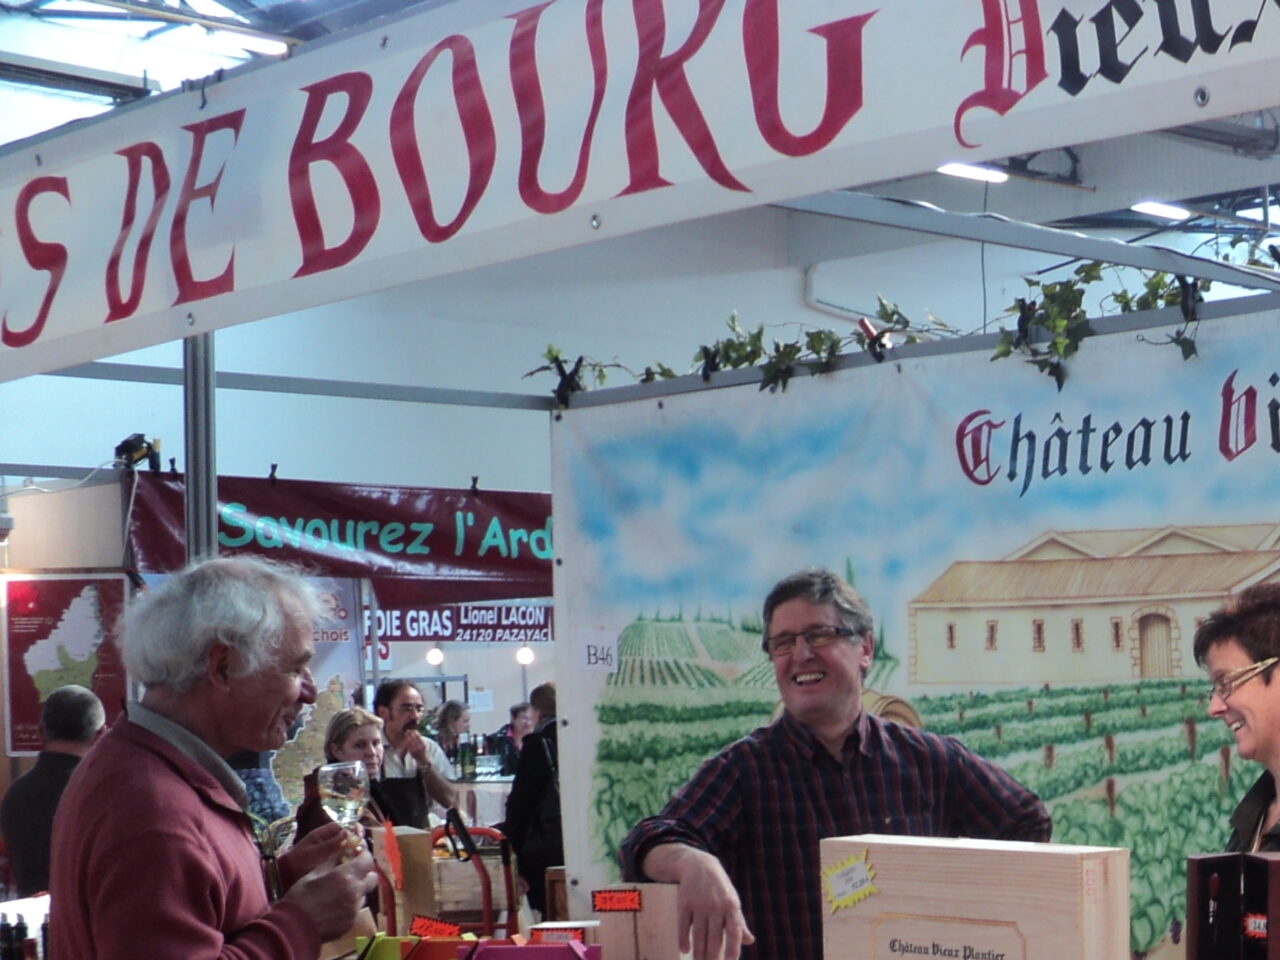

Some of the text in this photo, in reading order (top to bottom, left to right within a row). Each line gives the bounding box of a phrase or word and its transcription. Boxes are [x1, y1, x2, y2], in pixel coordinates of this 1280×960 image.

[104, 109, 247, 324] DE
[292, 0, 881, 279] BOURG
[955, 408, 1192, 498] Château
[218, 502, 434, 555] Savourez
[405, 608, 453, 638] GRAS
[460, 605, 545, 625] Lionel LACON
[455, 628, 549, 642] 24120 PAZAYAC
[587, 644, 613, 666] B46
